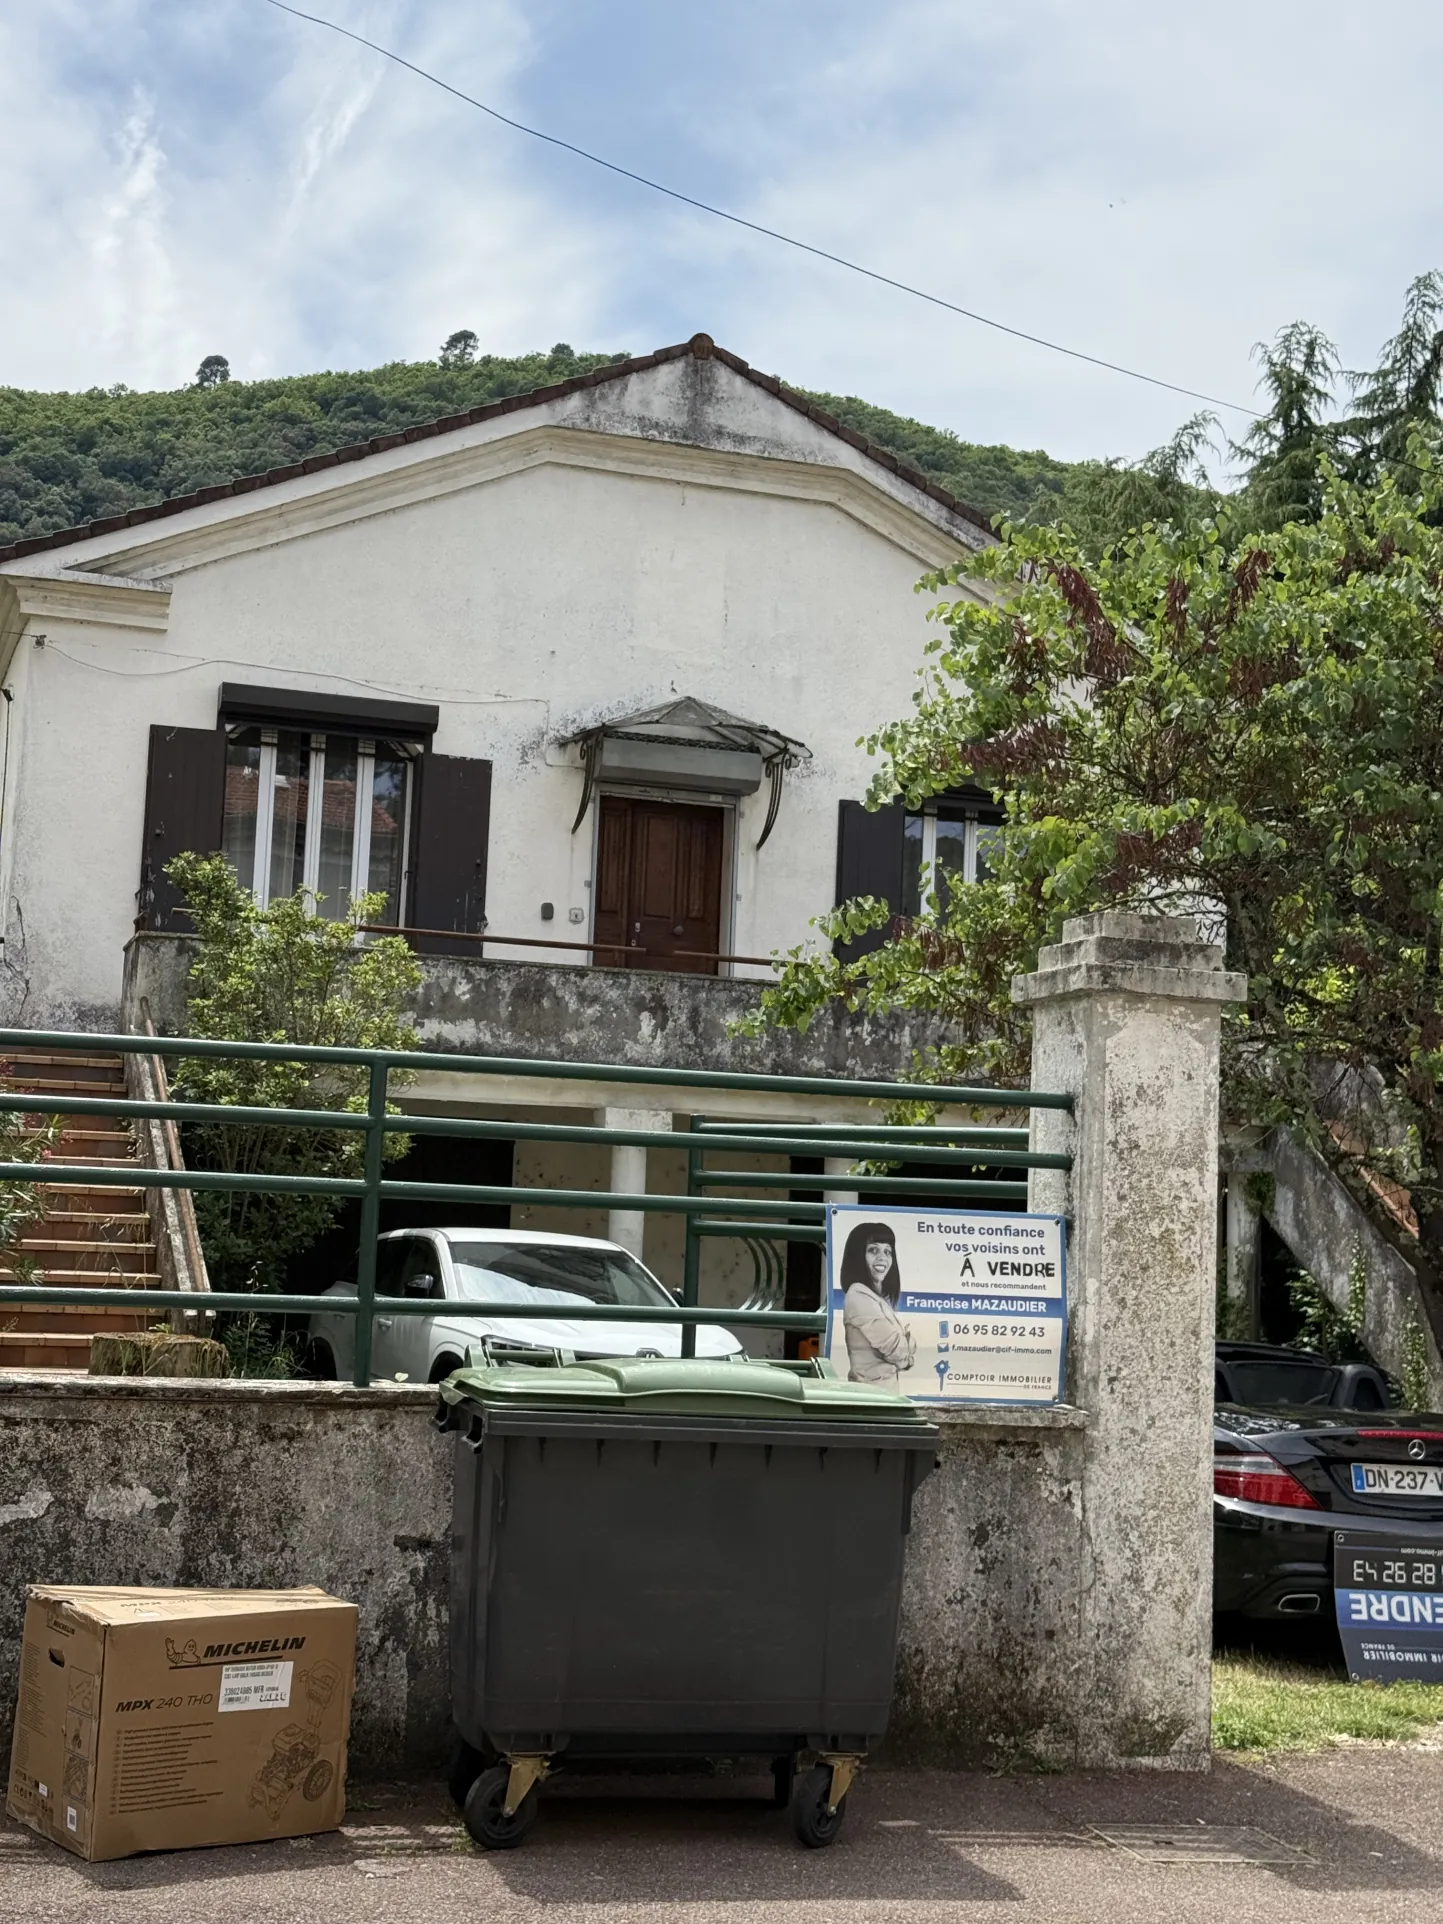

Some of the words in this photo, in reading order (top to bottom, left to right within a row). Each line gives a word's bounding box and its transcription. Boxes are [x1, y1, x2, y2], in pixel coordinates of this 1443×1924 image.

[917, 1221, 935, 1233] En
[937, 1222, 975, 1235] toute
[978, 1224, 1045, 1238] confiance
[945, 1242, 969, 1253] vos
[972, 1241, 1019, 1255] voisins
[1022, 1244, 1046, 1256] ont
[987, 1261, 1055, 1278] VENDRE
[990, 1282, 1047, 1291] recommandent
[906, 1296, 969, 1311] Françoise
[971, 1299, 1047, 1313] MAZAUDIER
[953, 1323, 969, 1335] 06
[972, 1324, 988, 1336] 95
[991, 1324, 1007, 1336] 82
[1010, 1325, 1026, 1337] 92
[1029, 1325, 1045, 1337] 43
[951, 1344, 1052, 1355] f.mazaudier@cif-immo.com
[947, 1373, 995, 1382] COMPTOIR
[998, 1375, 1052, 1384] IMMOBILIER
[1382, 1561, 1406, 1584] 92
[1412, 1562, 1436, 1585] 82
[203, 1636, 306, 1659] MICHELIN
[1362, 1650, 1427, 1662] IMMOBILIER
[1430, 1652, 1443, 1663] IR
[115, 1698, 155, 1712] MPX
[156, 1696, 183, 1709] 240
[187, 1693, 213, 1706] THO
